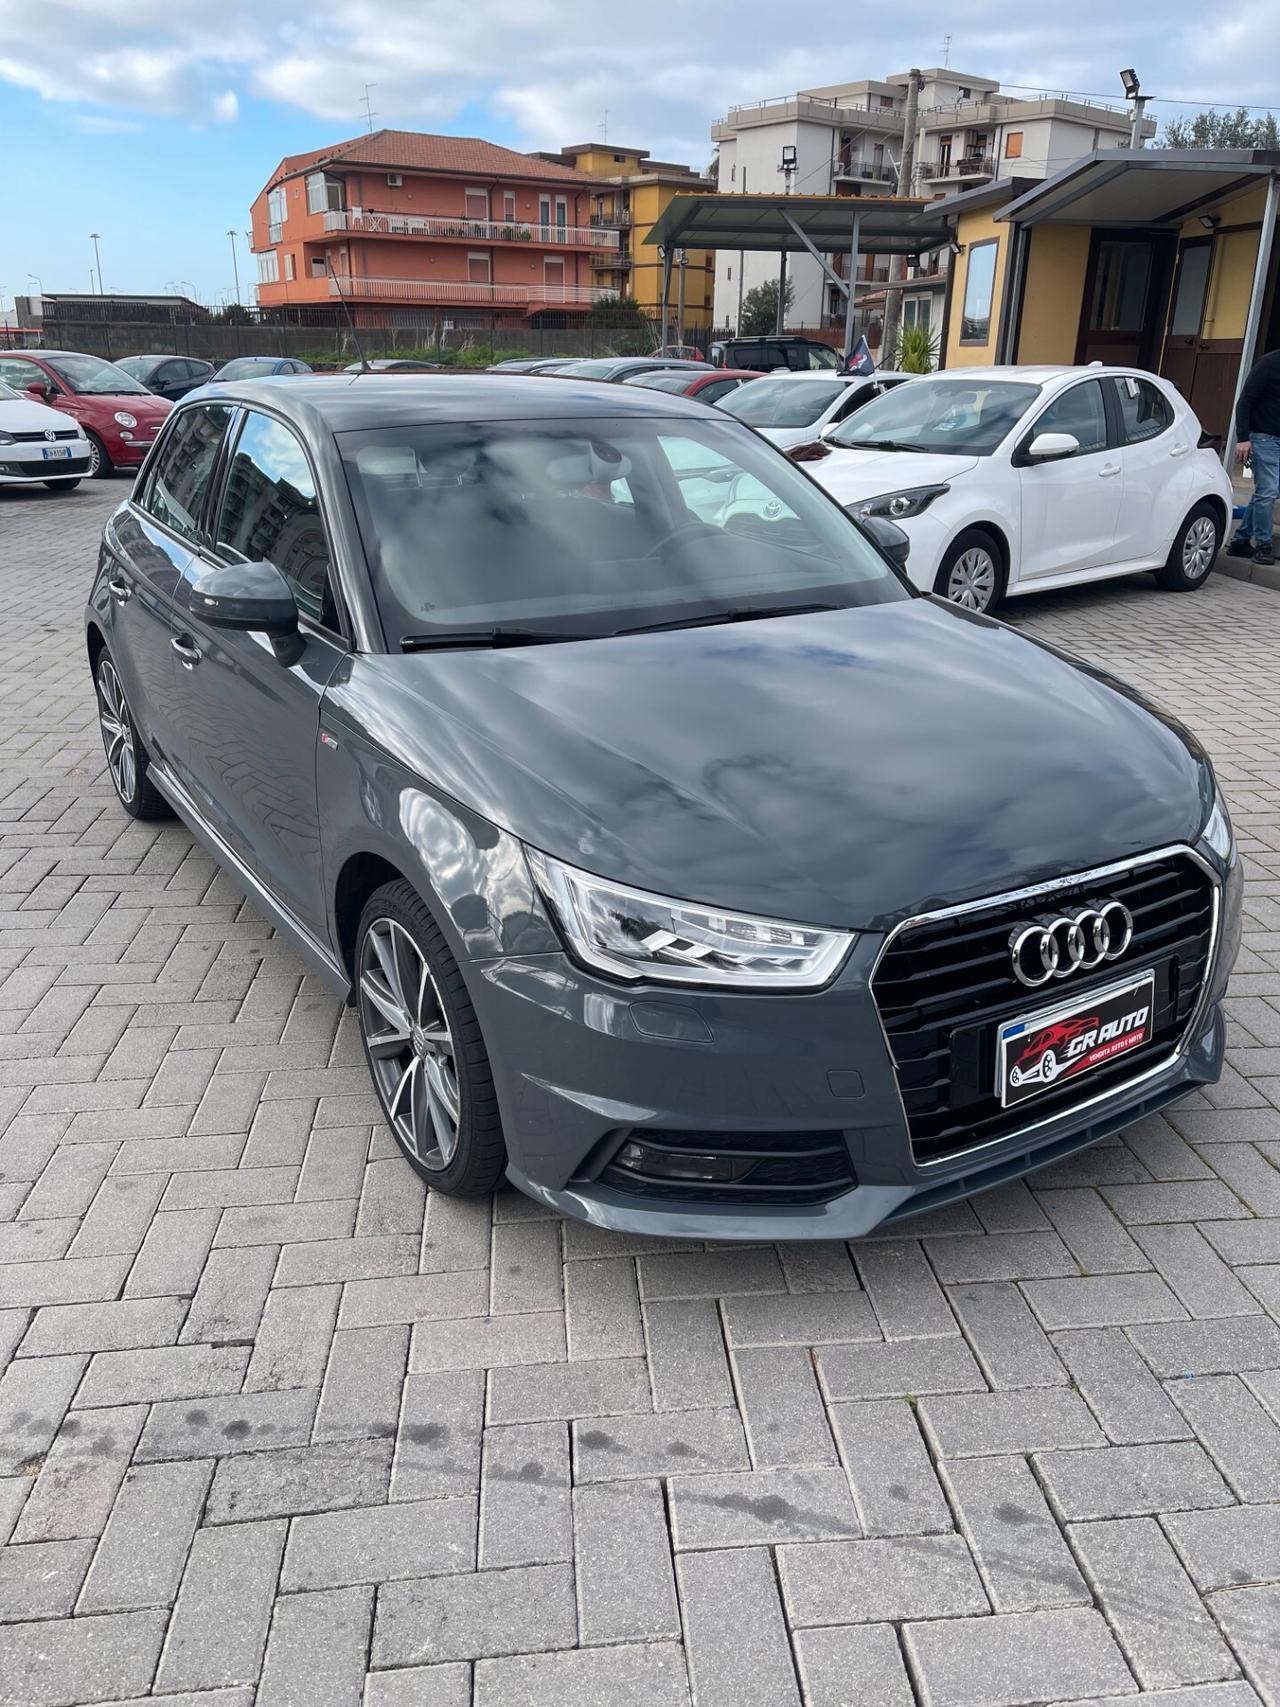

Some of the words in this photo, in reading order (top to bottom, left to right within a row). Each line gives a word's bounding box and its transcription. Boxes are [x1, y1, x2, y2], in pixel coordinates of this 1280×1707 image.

[1067, 1029, 1098, 1058] GR
[1098, 1006, 1149, 1044] AUTO
[1089, 1048, 1110, 1062] VENDITA
[1111, 1041, 1125, 1052] AUTO
[1129, 1033, 1143, 1044] MOTO
